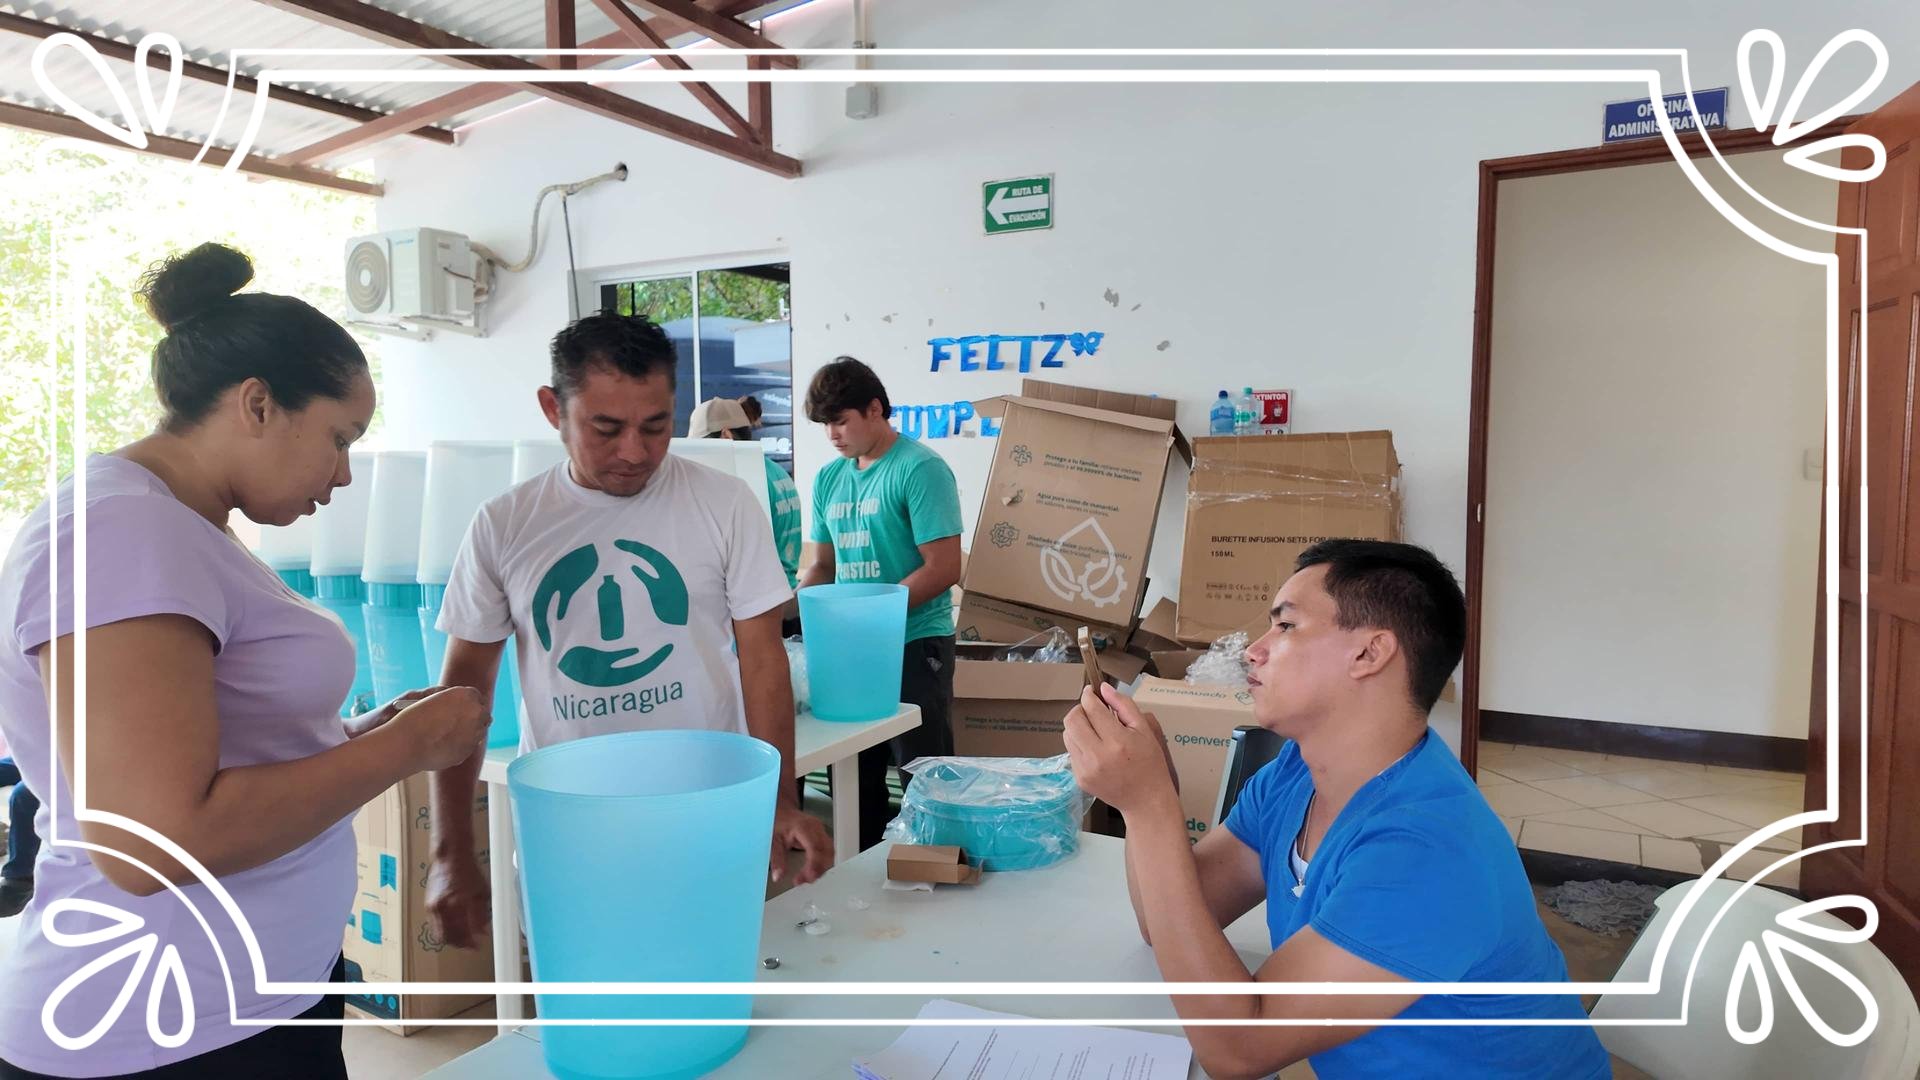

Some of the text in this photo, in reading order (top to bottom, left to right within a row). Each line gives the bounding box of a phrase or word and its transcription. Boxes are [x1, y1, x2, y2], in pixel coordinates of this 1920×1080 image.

[1637, 98, 1690, 117] OFINA
[1608, 112, 1720, 138] ADMINISRATVA
[1011, 185, 1043, 197] RUTA DE
[1252, 393, 1287, 401] XTINTOR
[1286, 536, 1307, 544] SETS
[553, 681, 683, 720] Nicaragua
[1186, 818, 1206, 832] de
